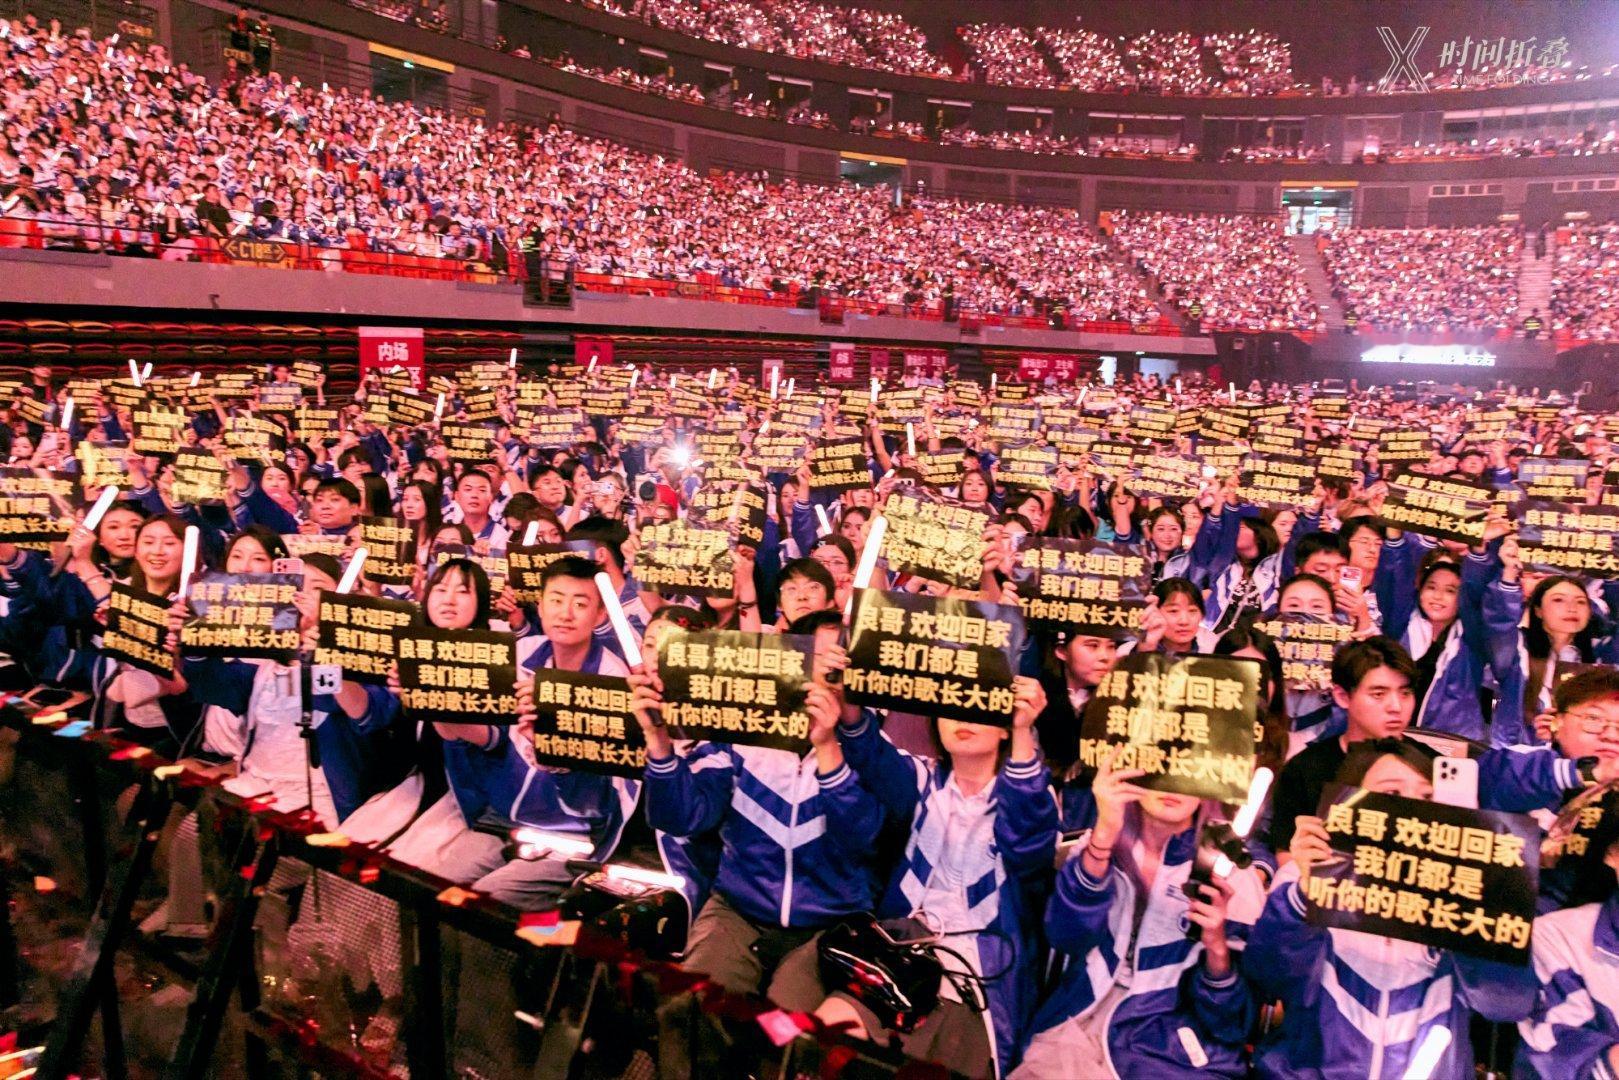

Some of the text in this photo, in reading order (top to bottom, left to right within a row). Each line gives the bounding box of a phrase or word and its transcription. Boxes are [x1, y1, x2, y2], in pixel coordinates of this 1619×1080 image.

[1064, 550, 1145, 577] 欢迎回家
[1040, 573, 1120, 602] 我们都是
[181, 627, 300, 651] 听你的歌长大的
[856, 605, 1012, 650] 良哥 欢迎回家
[399, 637, 510, 667] 良哥 欢迎回家
[666, 641, 806, 678] 良哥 欢迎回家
[878, 638, 979, 680] 我们都是
[418, 664, 490, 691] 我们都是
[538, 680, 573, 707] 良哥
[688, 674, 786, 706] 我们都是
[841, 667, 1016, 715] 听你的歌长大的
[1131, 671, 1244, 710] 欢迎回家
[555, 710, 626, 741] 我们都是
[660, 701, 810, 740] 听你的歌长大的
[1323, 802, 1526, 869] 良哥 欢迎回家
[1353, 843, 1484, 904] 我们都是
[1306, 874, 1532, 950] 听你的歌长大的
